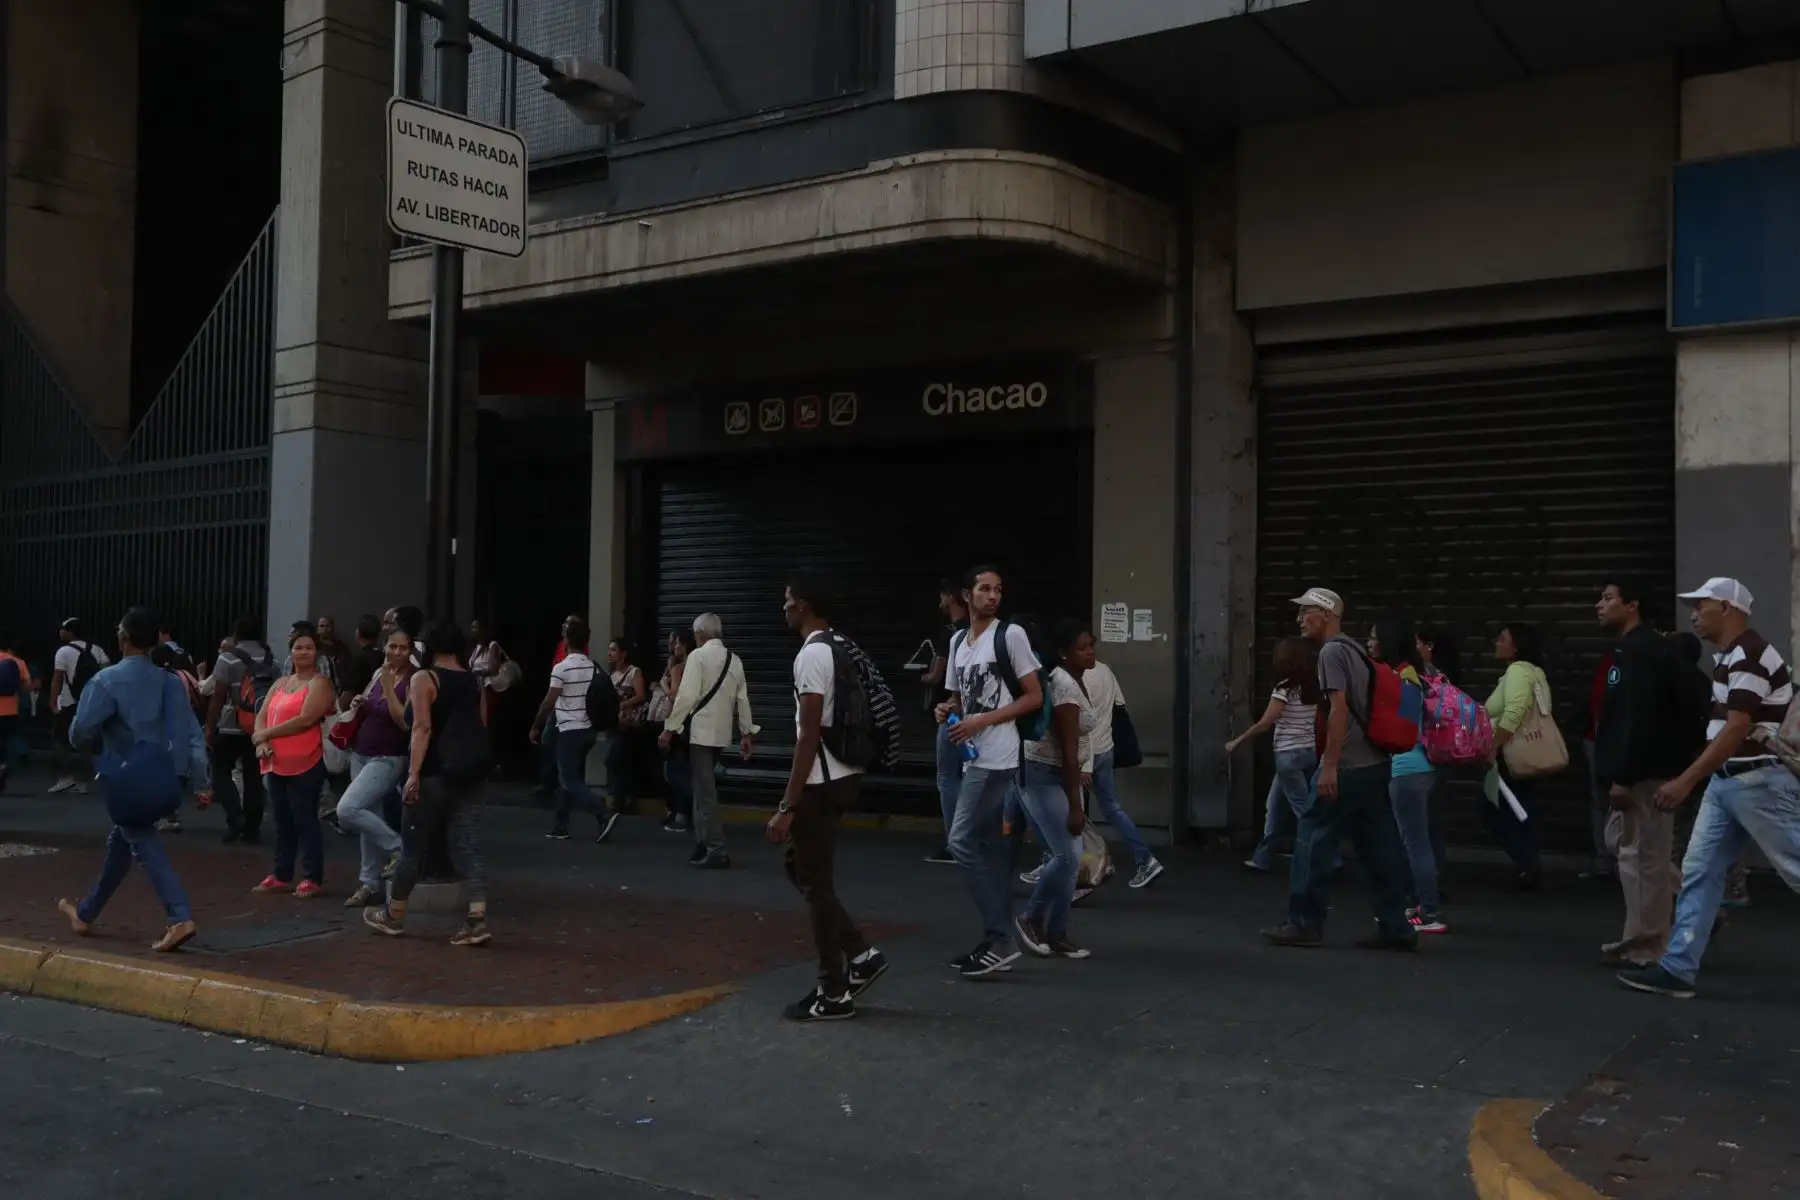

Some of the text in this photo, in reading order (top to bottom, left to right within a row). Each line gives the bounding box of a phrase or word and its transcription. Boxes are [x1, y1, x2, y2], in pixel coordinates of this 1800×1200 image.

[397, 118, 519, 168] ULTIMA PARADA
[408, 160, 509, 200] RUTAS HACIA
[397, 197, 520, 240] AV. LIBERTADOR
[922, 381, 1048, 416] Chacao
